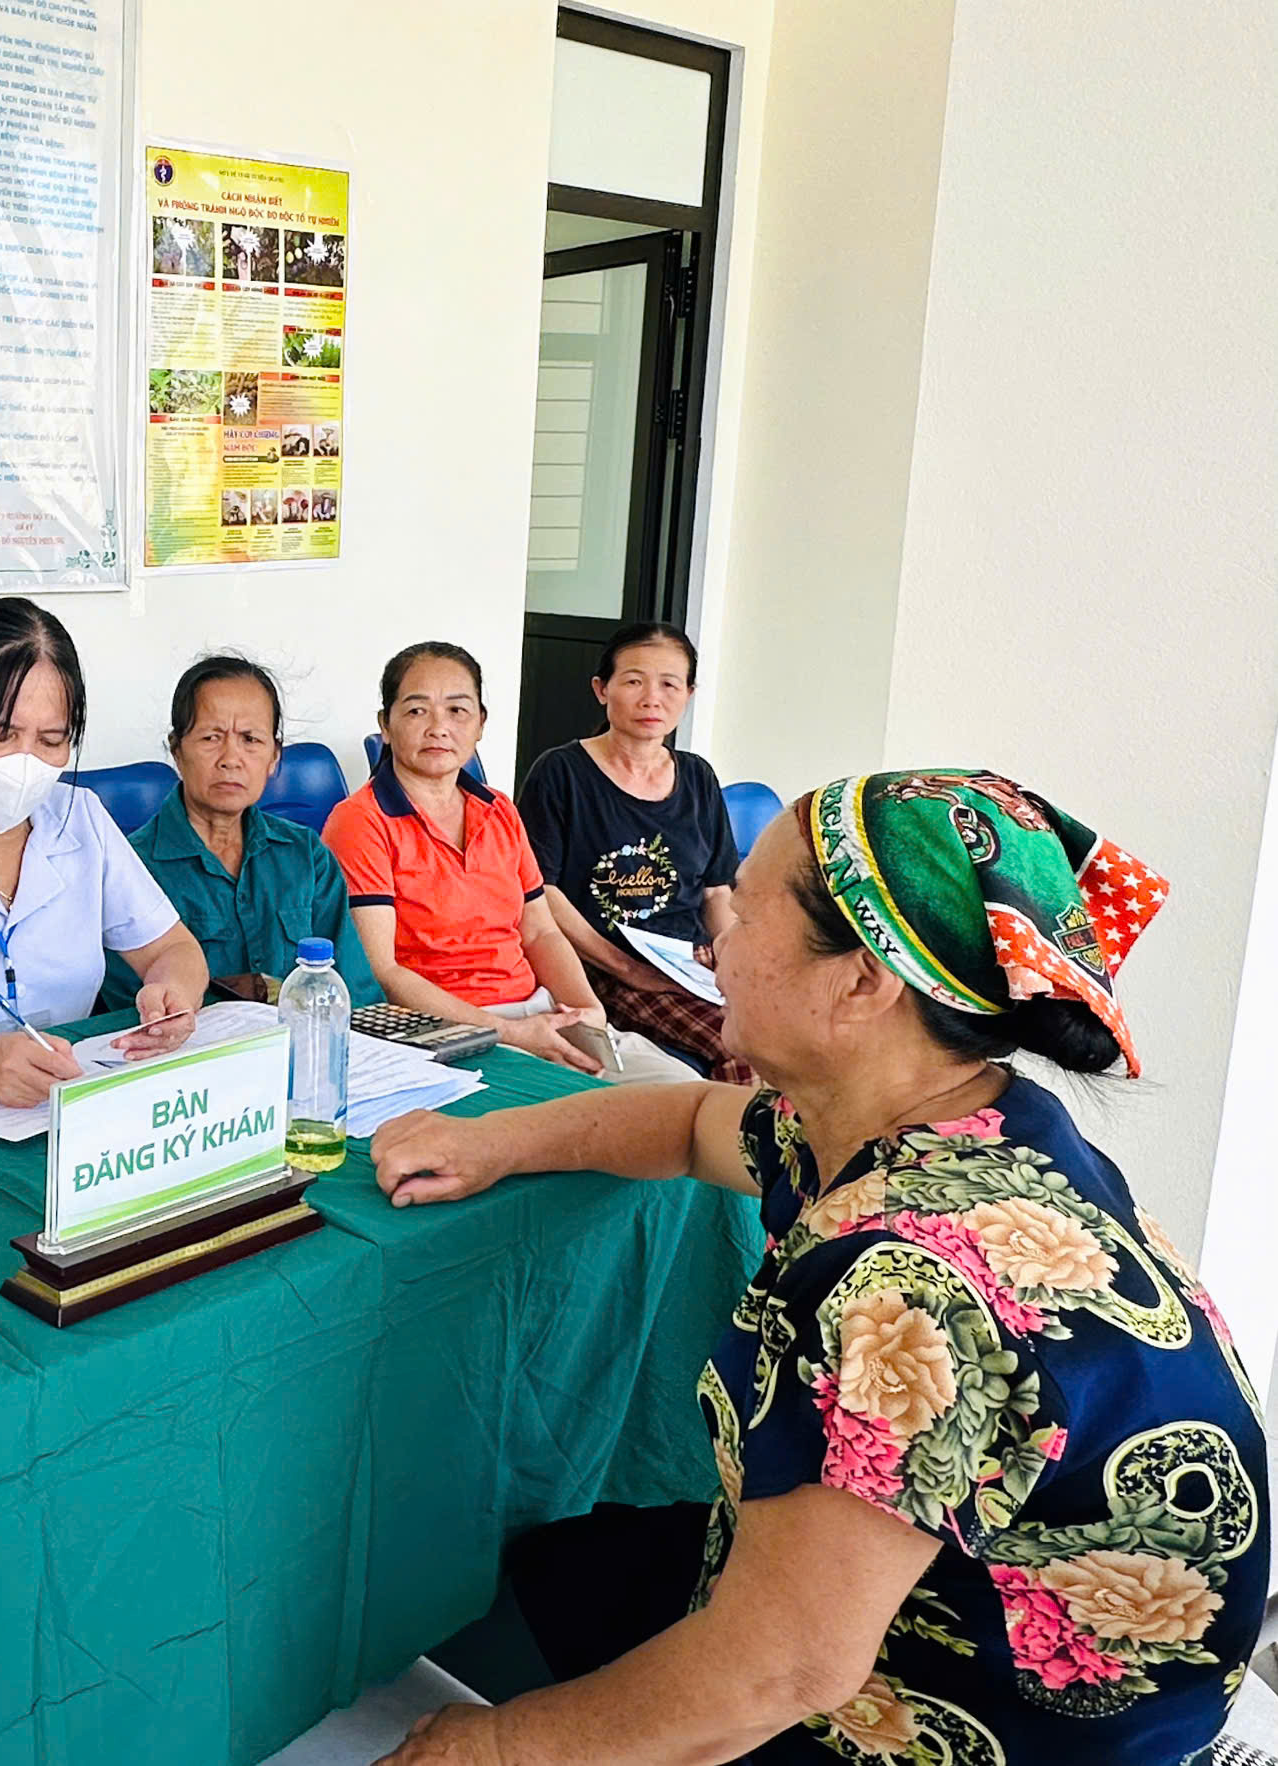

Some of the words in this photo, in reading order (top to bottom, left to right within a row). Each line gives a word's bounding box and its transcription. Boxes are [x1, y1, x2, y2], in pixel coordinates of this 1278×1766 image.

[853, 894, 901, 957] WAY
[152, 1088, 208, 1128] BÀN
[72, 1143, 154, 1192] ĐĂNG
[163, 1124, 196, 1164] KÝ
[202, 1106, 274, 1152] KHÁM
